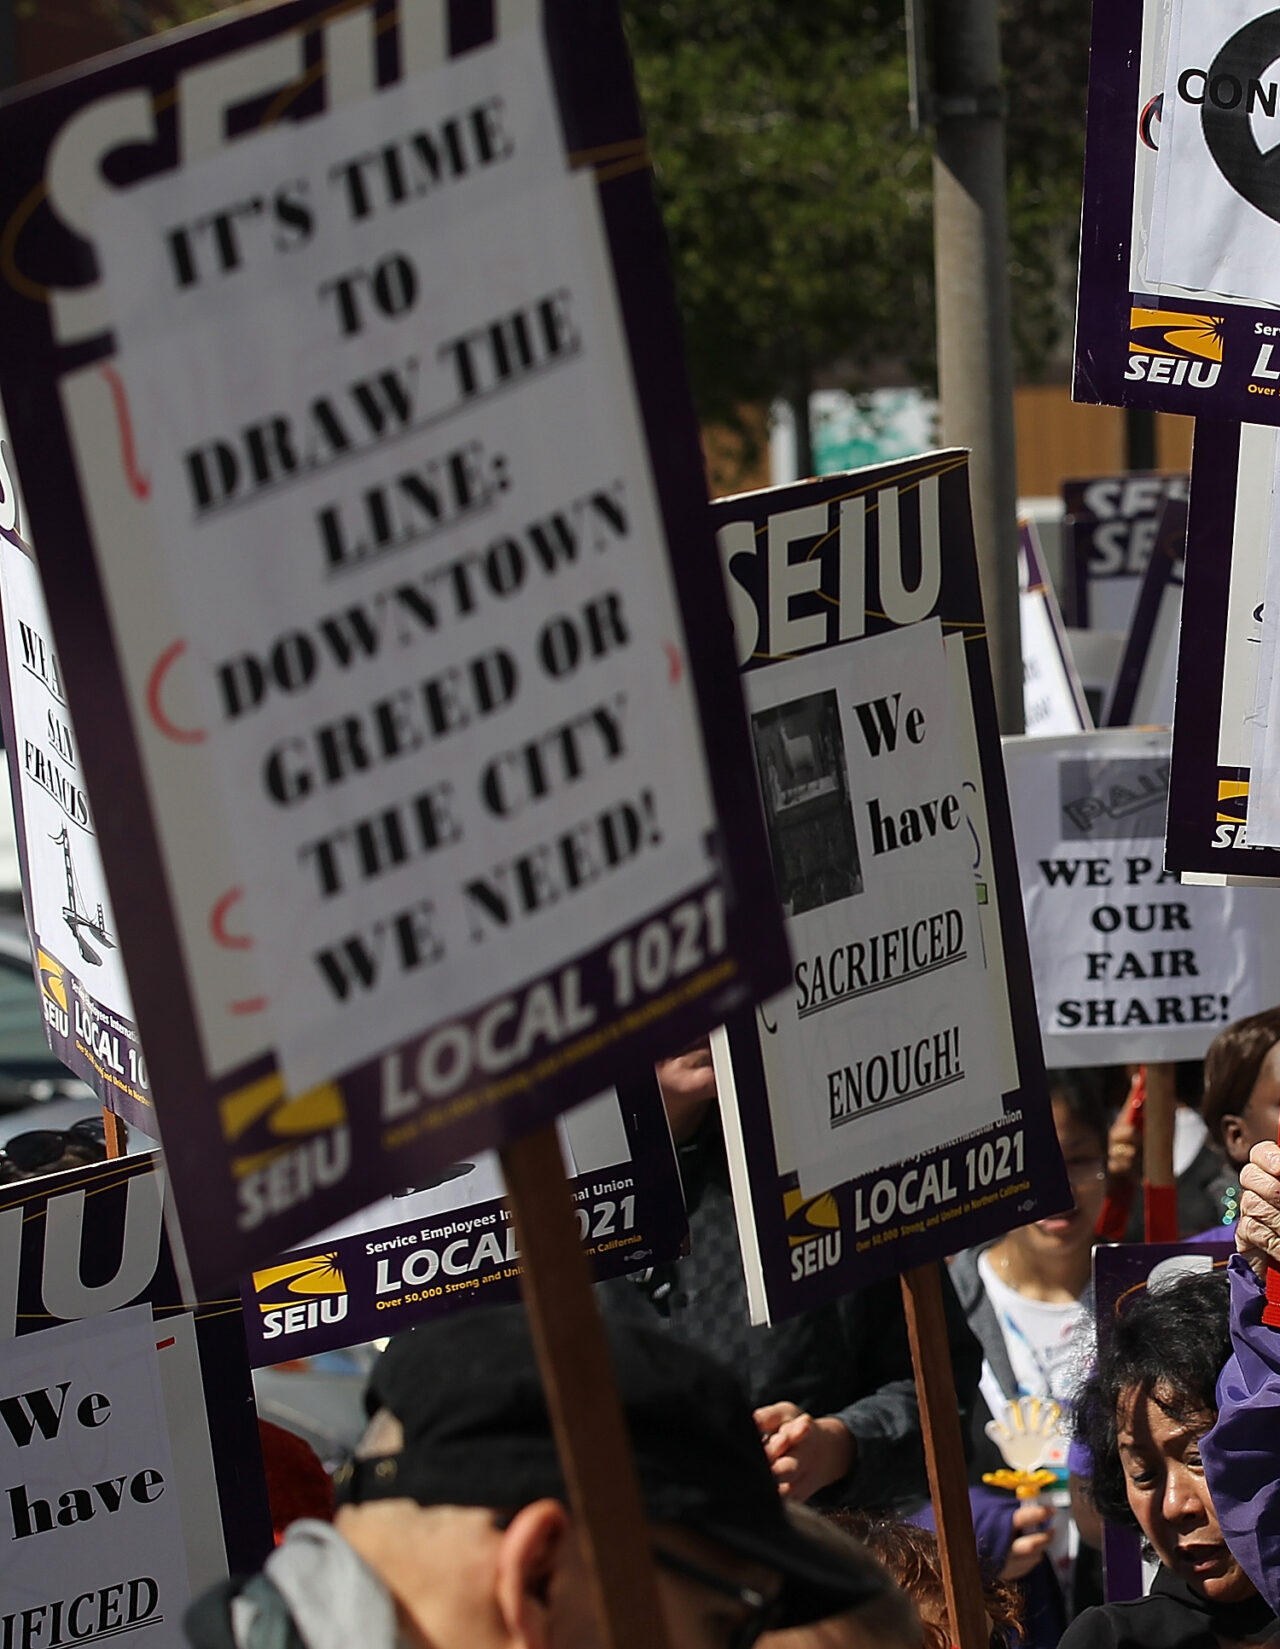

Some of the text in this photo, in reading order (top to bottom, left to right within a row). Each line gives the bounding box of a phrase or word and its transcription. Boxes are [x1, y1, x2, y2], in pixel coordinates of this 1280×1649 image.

[163, 95, 516, 291] IT'S TIME
[319, 252, 418, 339] TO
[183, 288, 582, 514] DRAW THE
[1123, 354, 1222, 389] SEIU
[1248, 383, 1276, 397] Over
[318, 438, 513, 572] LINE:
[213, 480, 635, 722] DOWNTOWN
[716, 474, 942, 669] SEIU
[18, 619, 49, 682] WE
[262, 589, 632, 809] GREED OR
[853, 692, 928, 759] We
[47, 708, 76, 764] SAN
[299, 691, 631, 902] THE CITY
[866, 793, 962, 857] have
[312, 790, 665, 1004] WE NEED!
[1037, 858, 1113, 887] WE
[1091, 902, 1192, 933] OUR
[794, 908, 964, 1012] SACRIFICED
[1085, 949, 1200, 981] FAIR
[43, 998, 70, 1039] SEIU
[380, 965, 598, 1120] LOCAL
[605, 891, 730, 1007] 1021
[1056, 995, 1230, 1028] SHARE!
[74, 1000, 125, 1076] LOCAL
[128, 1047, 150, 1091] 10
[827, 1025, 961, 1122] ENOUGH!
[234, 1124, 352, 1233] SEIU
[593, 1176, 635, 1197] Union
[855, 1158, 958, 1234] LOCAL
[966, 1129, 1025, 1193] 1021
[364, 1212, 498, 1257] Service Employees
[375, 1227, 522, 1296] LOCAL
[597, 1234, 643, 1254] California
[790, 1229, 842, 1282] SEIU
[262, 1294, 349, 1340] SEIU
[376, 1297, 402, 1312] Over
[404, 1286, 443, 1304] 50,000
[445, 1277, 480, 1293] Strong
[481, 1272, 502, 1285] and
[0, 1381, 112, 1449] We
[5, 1467, 167, 1540] have
[0, 1576, 161, 1649] IFICED
